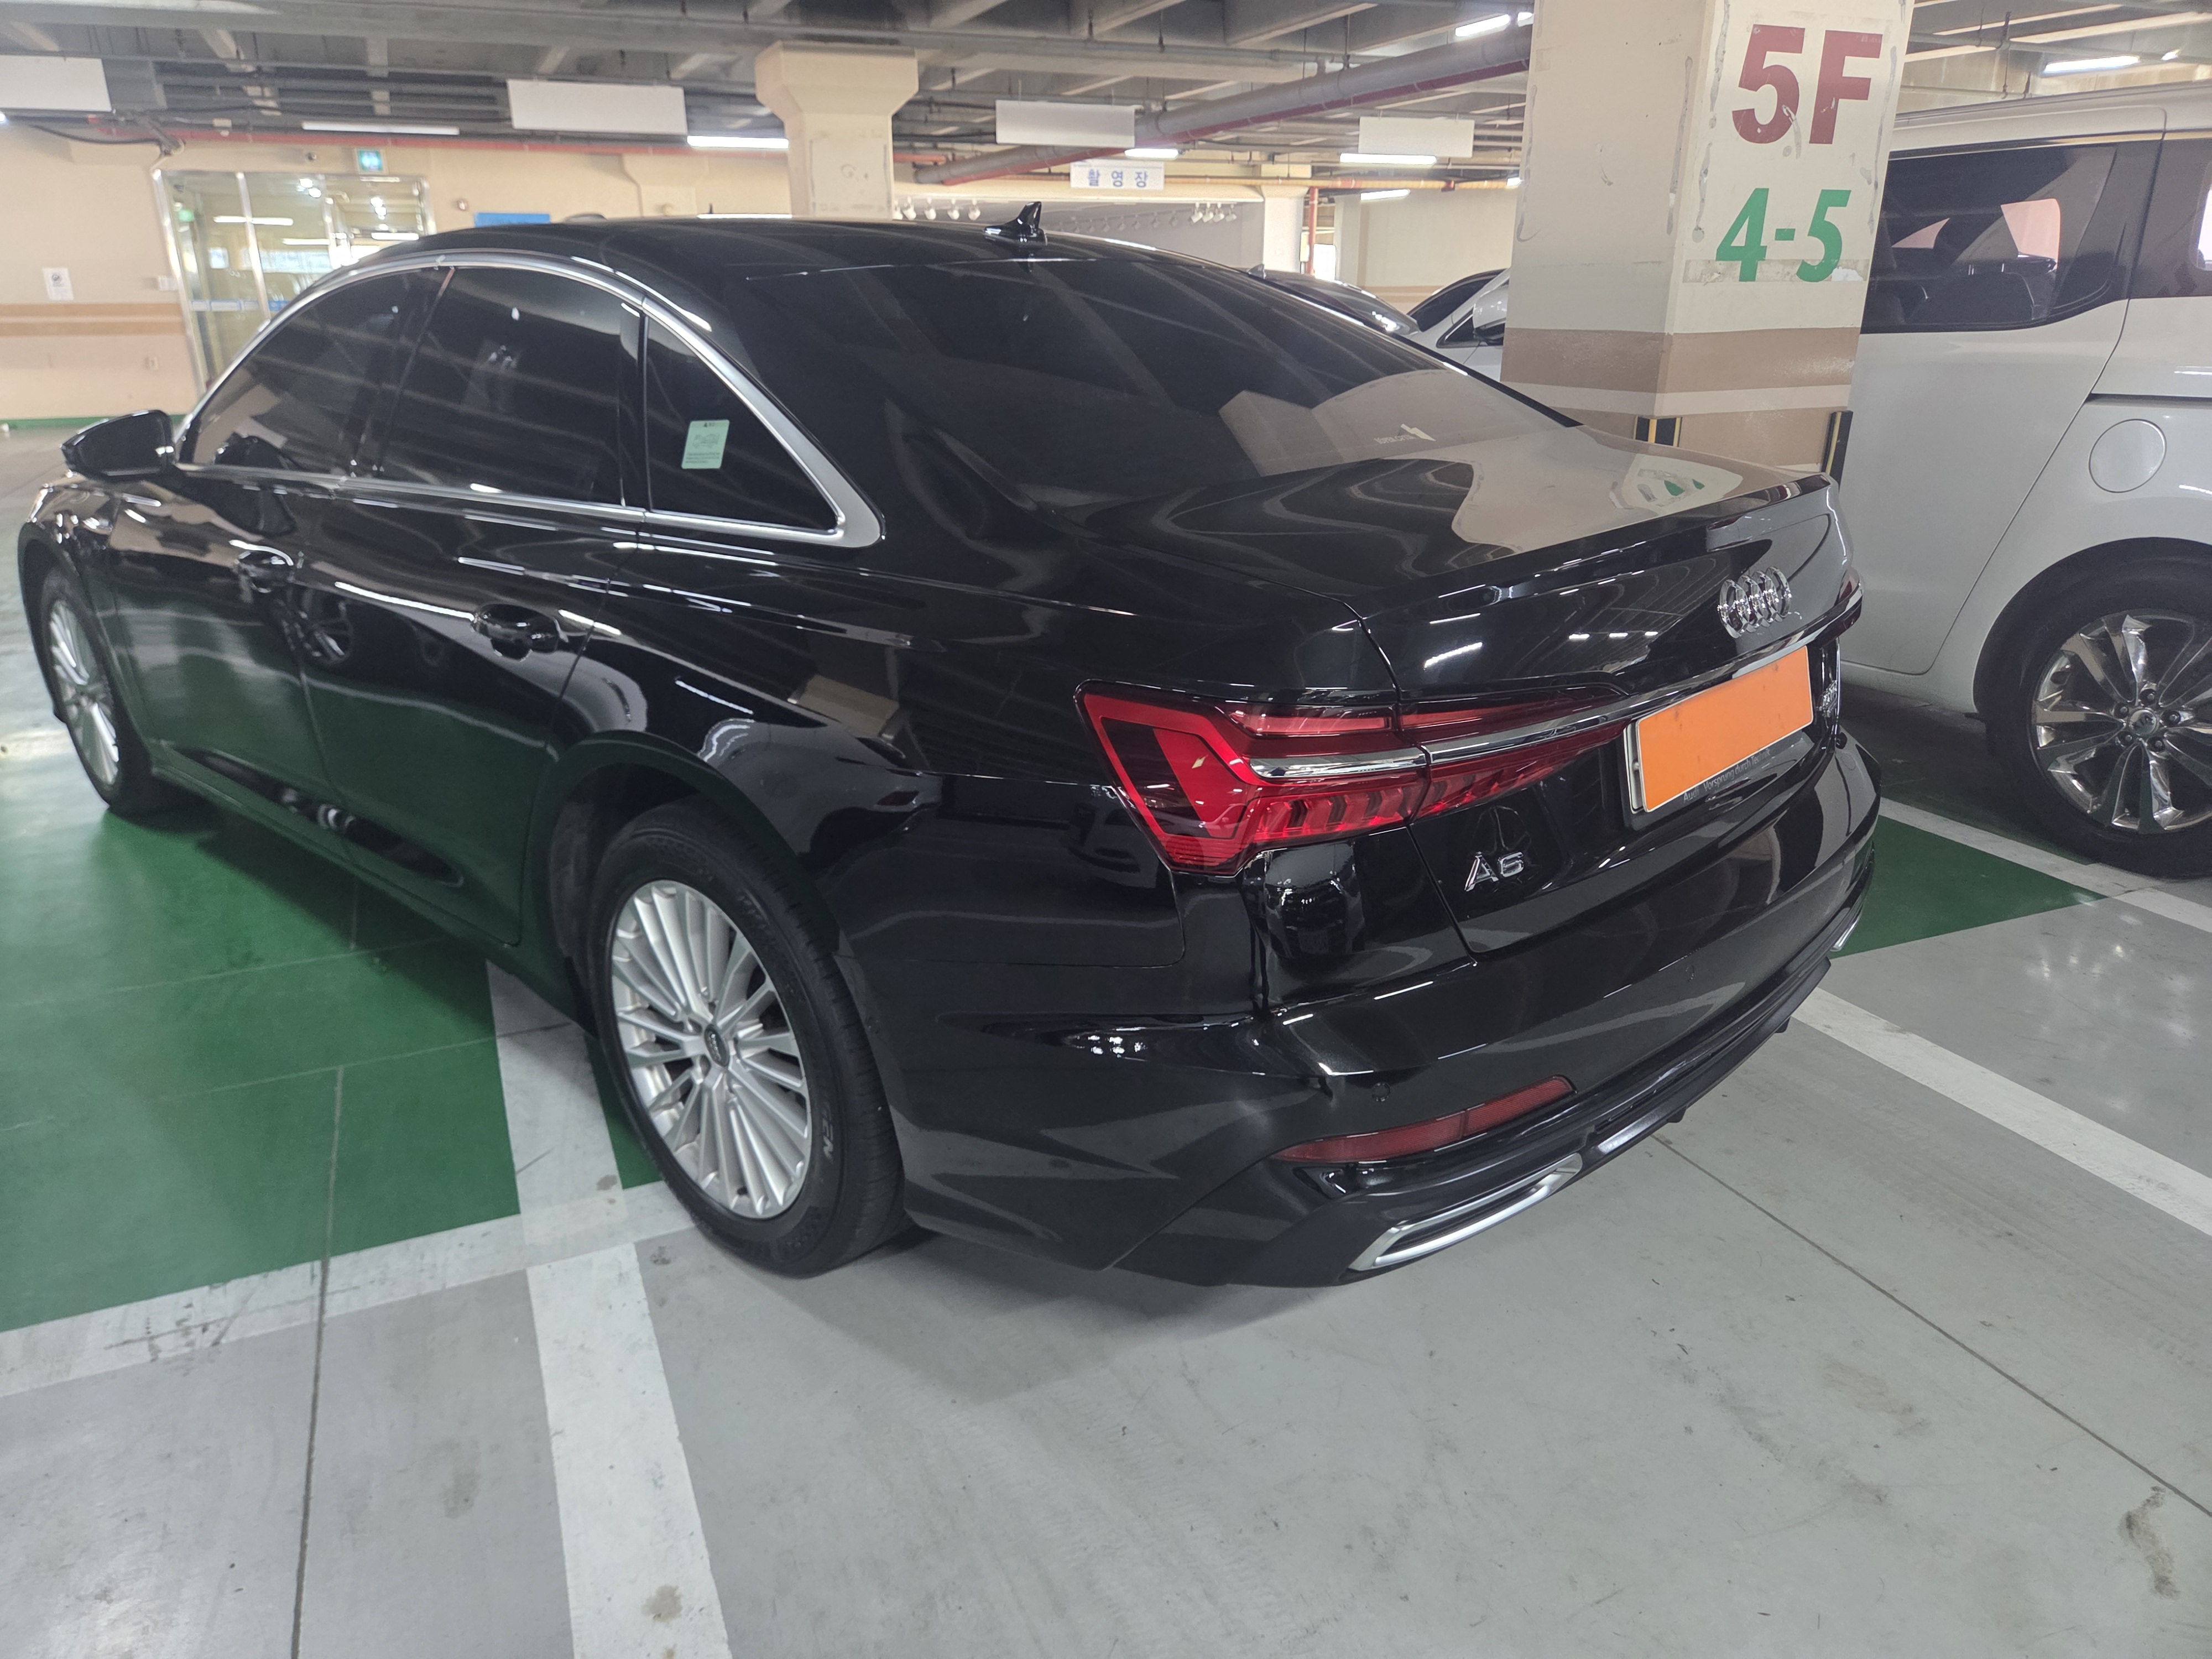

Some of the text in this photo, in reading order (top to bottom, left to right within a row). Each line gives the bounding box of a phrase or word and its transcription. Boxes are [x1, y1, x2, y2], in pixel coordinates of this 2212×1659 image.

[1731, 24, 1883, 144] 5F
[1088, 169, 1149, 187] 촬영장
[1715, 188, 1852, 283] 4-5
[1683, 786, 1699, 802] Audi
[1703, 770, 1735, 791] Vorsprung
[1735, 759, 1751, 774] durch
[1464, 852, 1524, 891] A6
